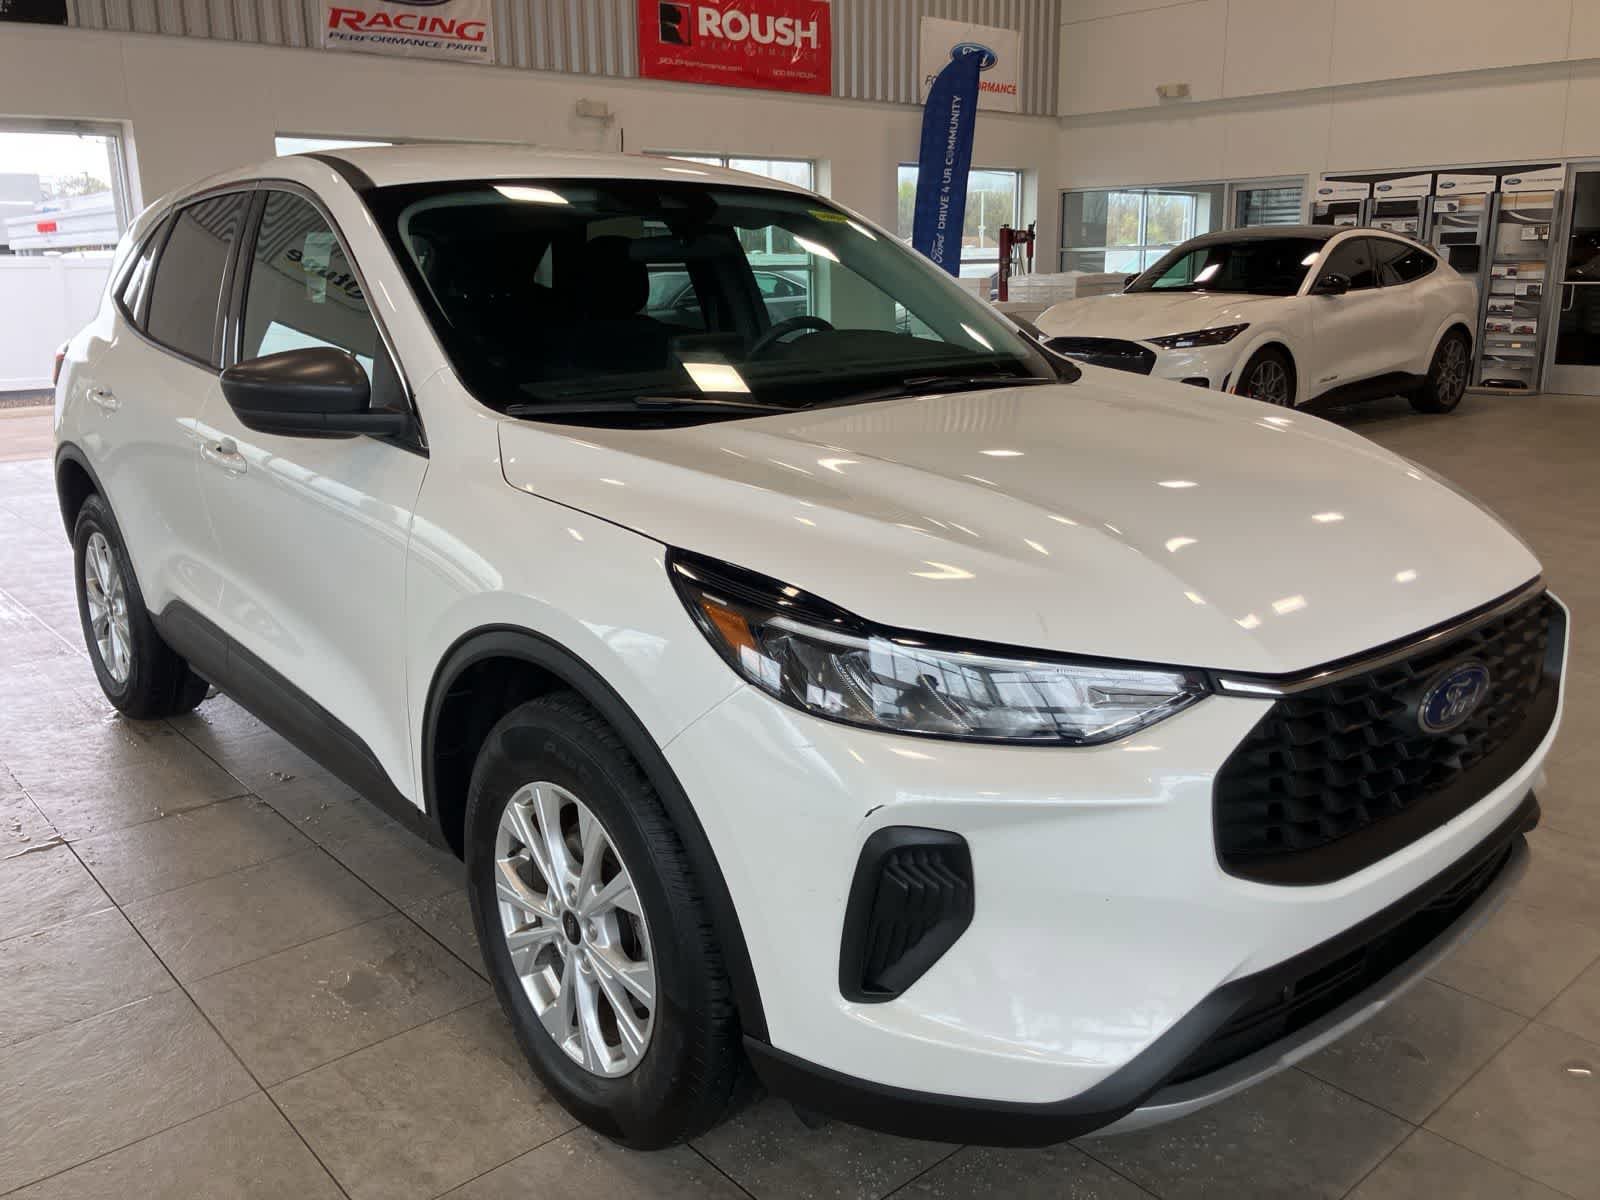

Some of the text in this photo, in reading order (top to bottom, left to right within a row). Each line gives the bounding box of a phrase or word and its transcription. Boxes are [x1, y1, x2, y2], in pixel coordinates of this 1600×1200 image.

[328, 7, 487, 42] RACING
[697, 6, 818, 49] ROUSH
[328, 32, 488, 53] PERFORMANCE PARTS
[945, 95, 962, 165] COMMUNITY
[942, 168, 952, 184] UR
[937, 194, 950, 230] DRIVE
[930, 232, 945, 264] Ford
